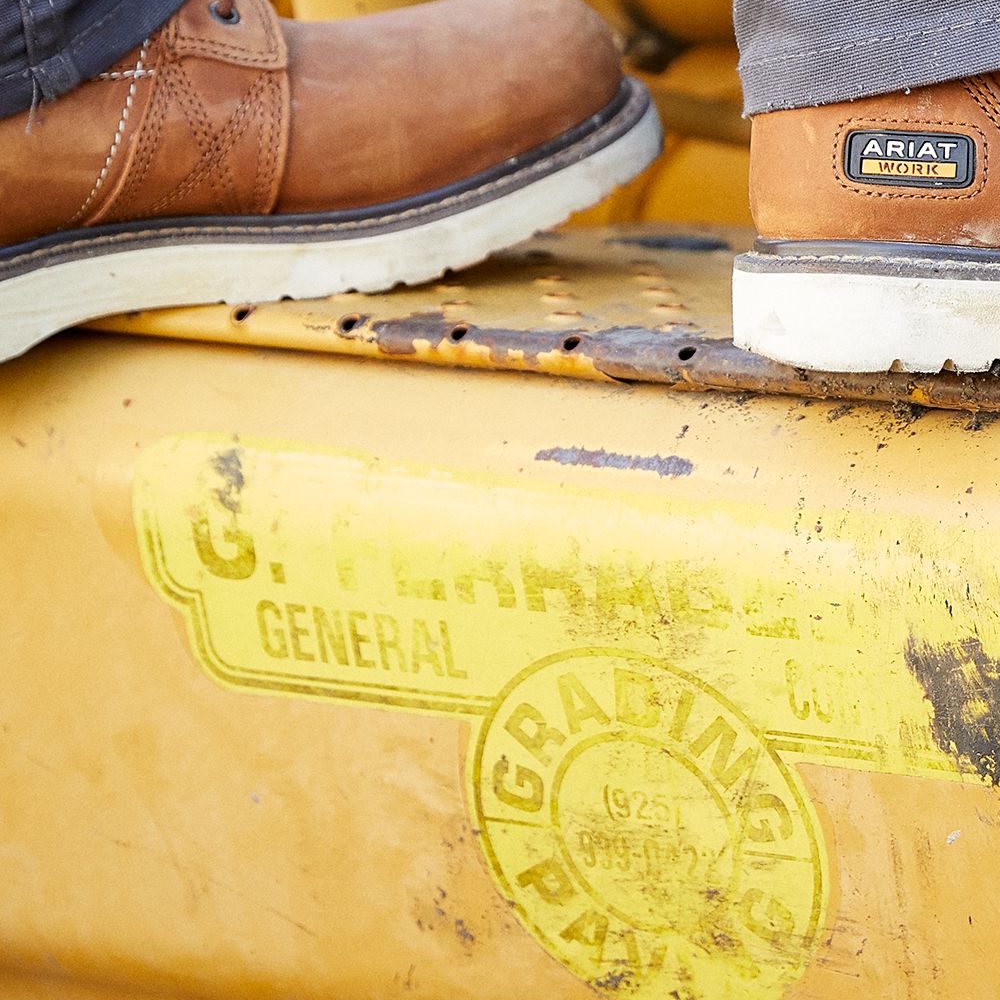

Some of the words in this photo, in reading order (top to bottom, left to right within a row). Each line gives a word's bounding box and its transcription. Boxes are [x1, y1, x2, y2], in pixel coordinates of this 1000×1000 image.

[862, 139, 958, 160] ARIAT
[878, 161, 939, 176] WORK
[256, 599, 467, 679] GENERAL
[491, 668, 793, 843] GRADING
